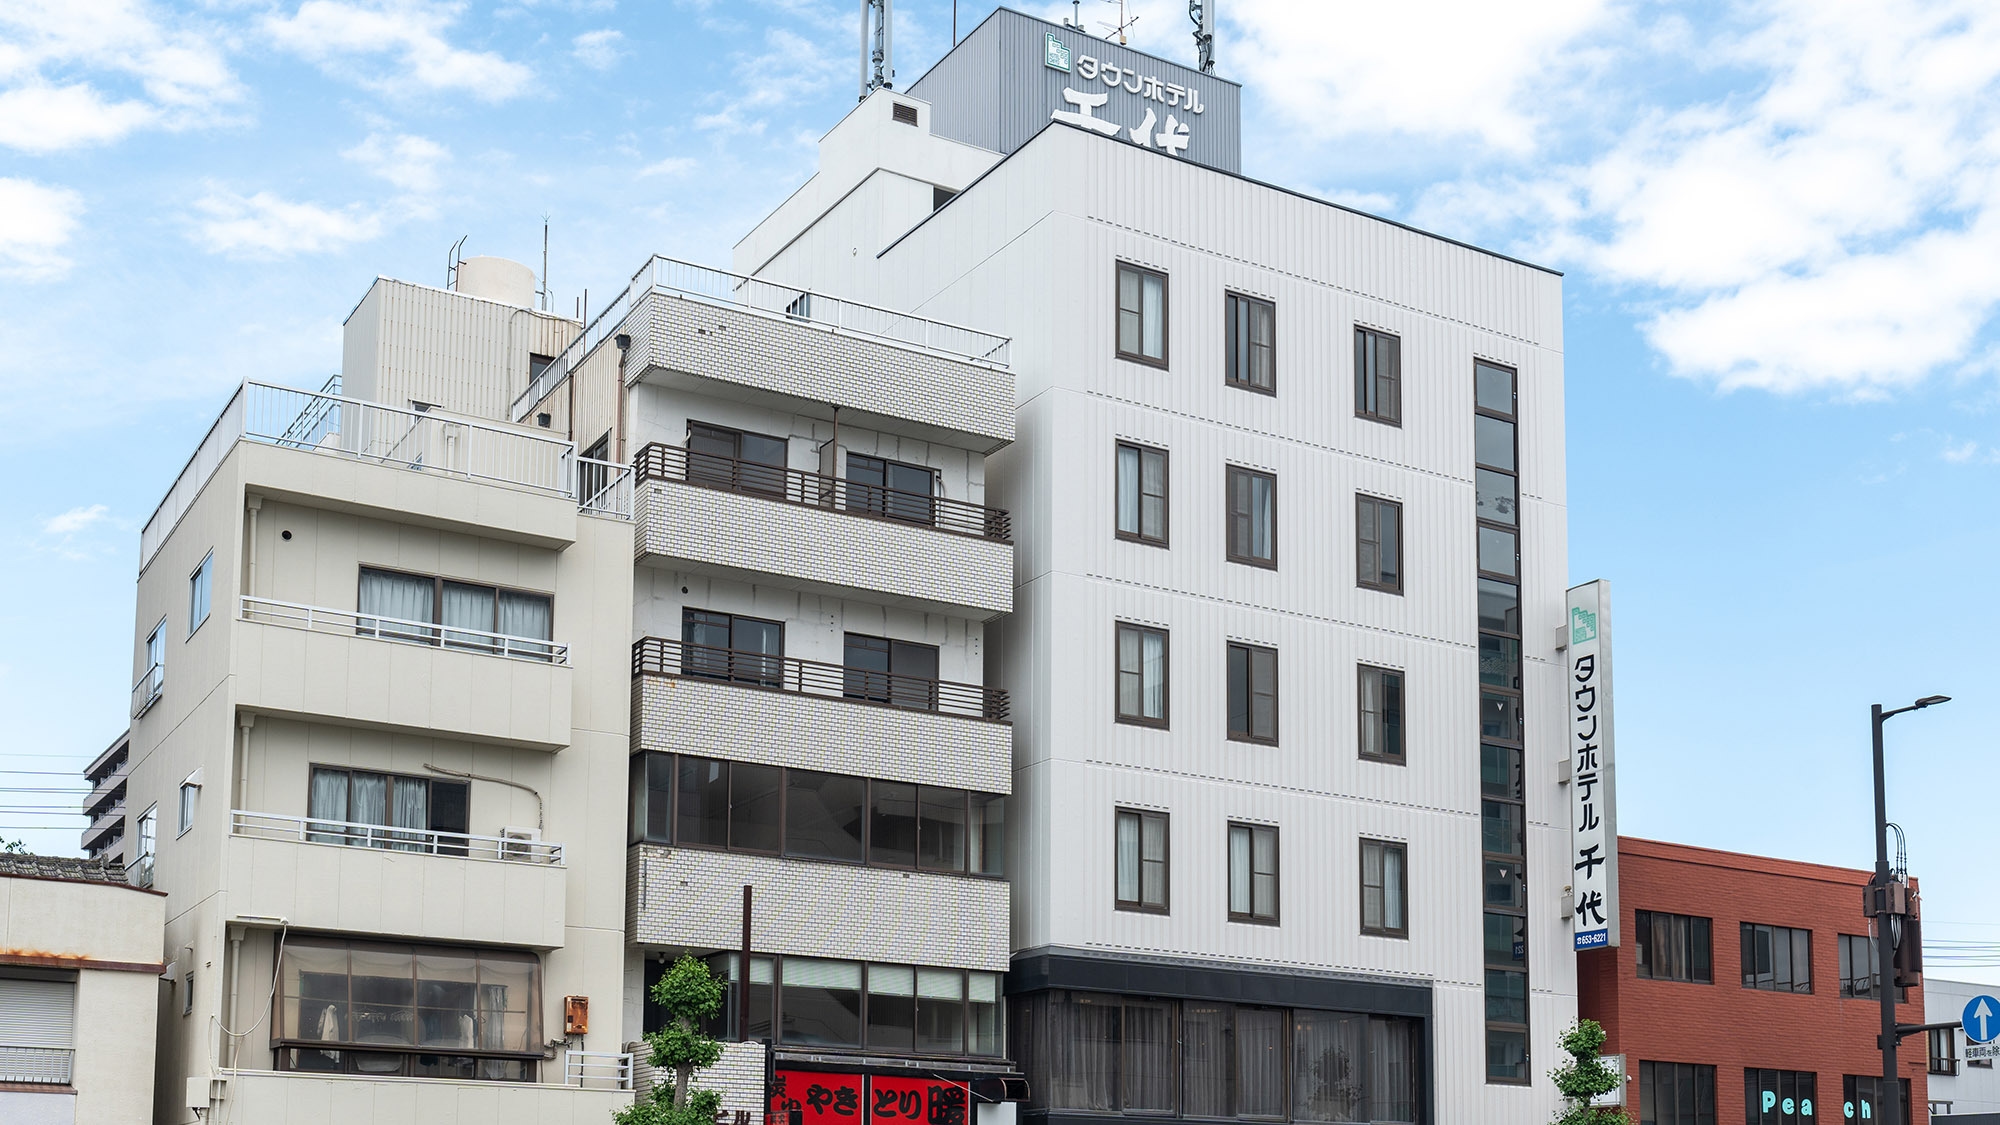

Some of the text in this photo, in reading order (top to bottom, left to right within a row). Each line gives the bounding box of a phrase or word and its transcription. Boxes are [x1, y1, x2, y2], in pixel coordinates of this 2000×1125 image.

[1077, 54, 1204, 115] タウンホテル
[1574, 654, 1607, 927] タウンホテル 千代
